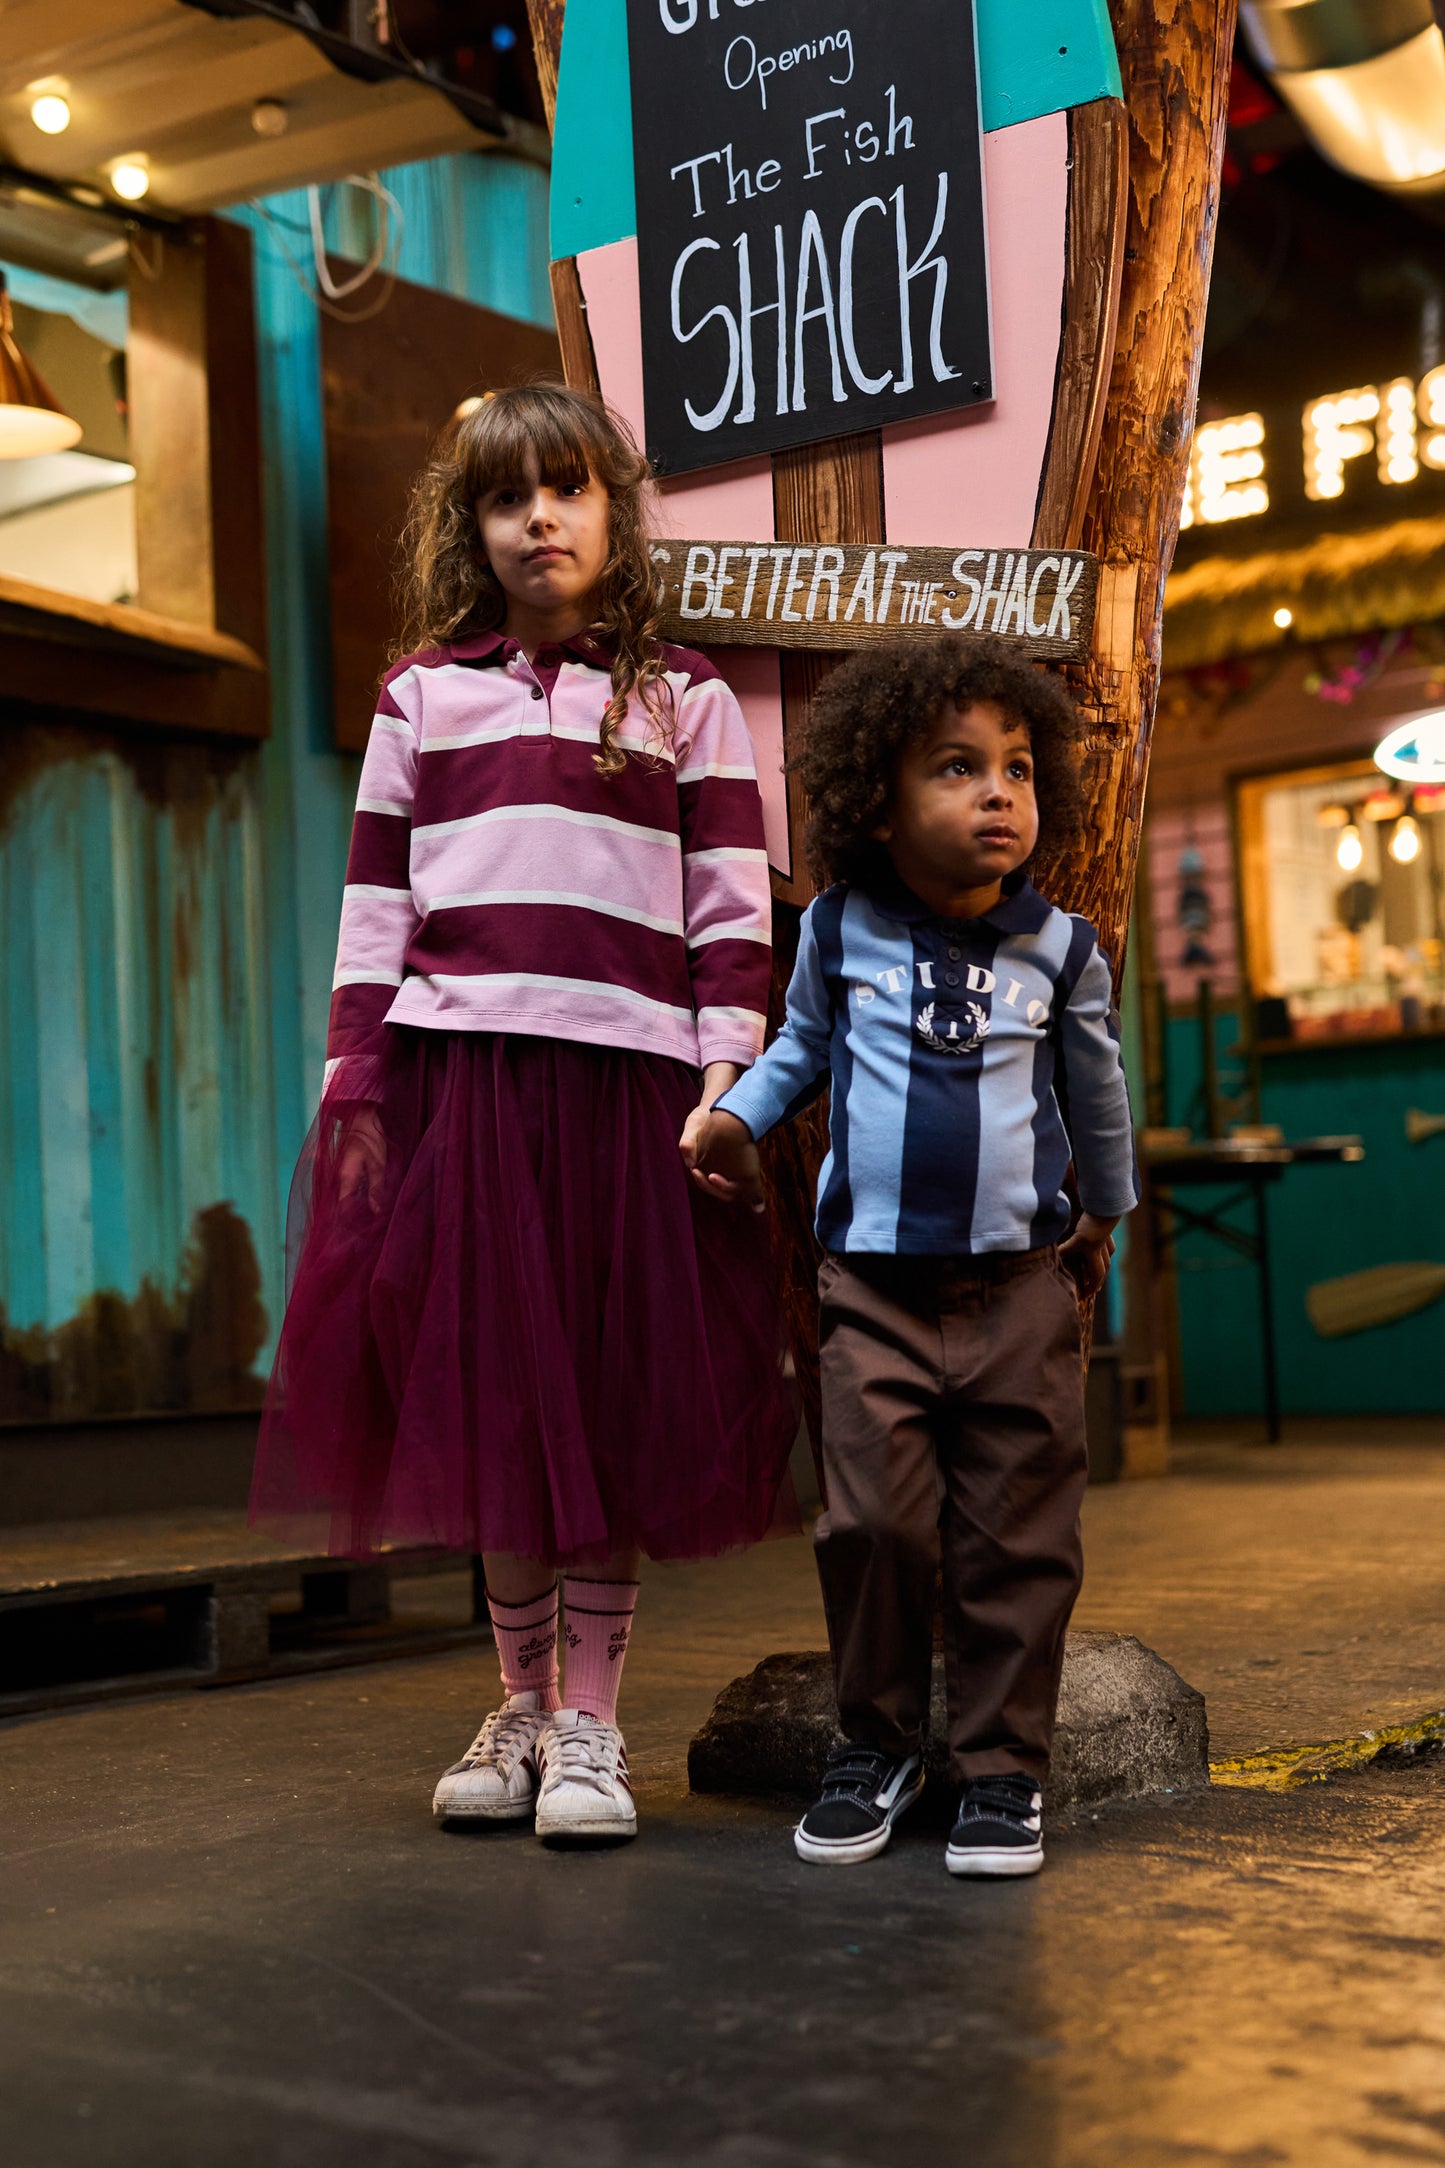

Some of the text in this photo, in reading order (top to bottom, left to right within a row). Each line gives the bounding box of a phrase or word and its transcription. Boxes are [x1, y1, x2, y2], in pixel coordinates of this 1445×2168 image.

[724, 29, 854, 110] Opening
[671, 84, 916, 217] The Fish
[671, 172, 962, 432] SHACK
[679, 546, 845, 622] BETTER
[844, 551, 908, 624] AT
[900, 580, 948, 625] THE
[942, 550, 1084, 641] SHACK
